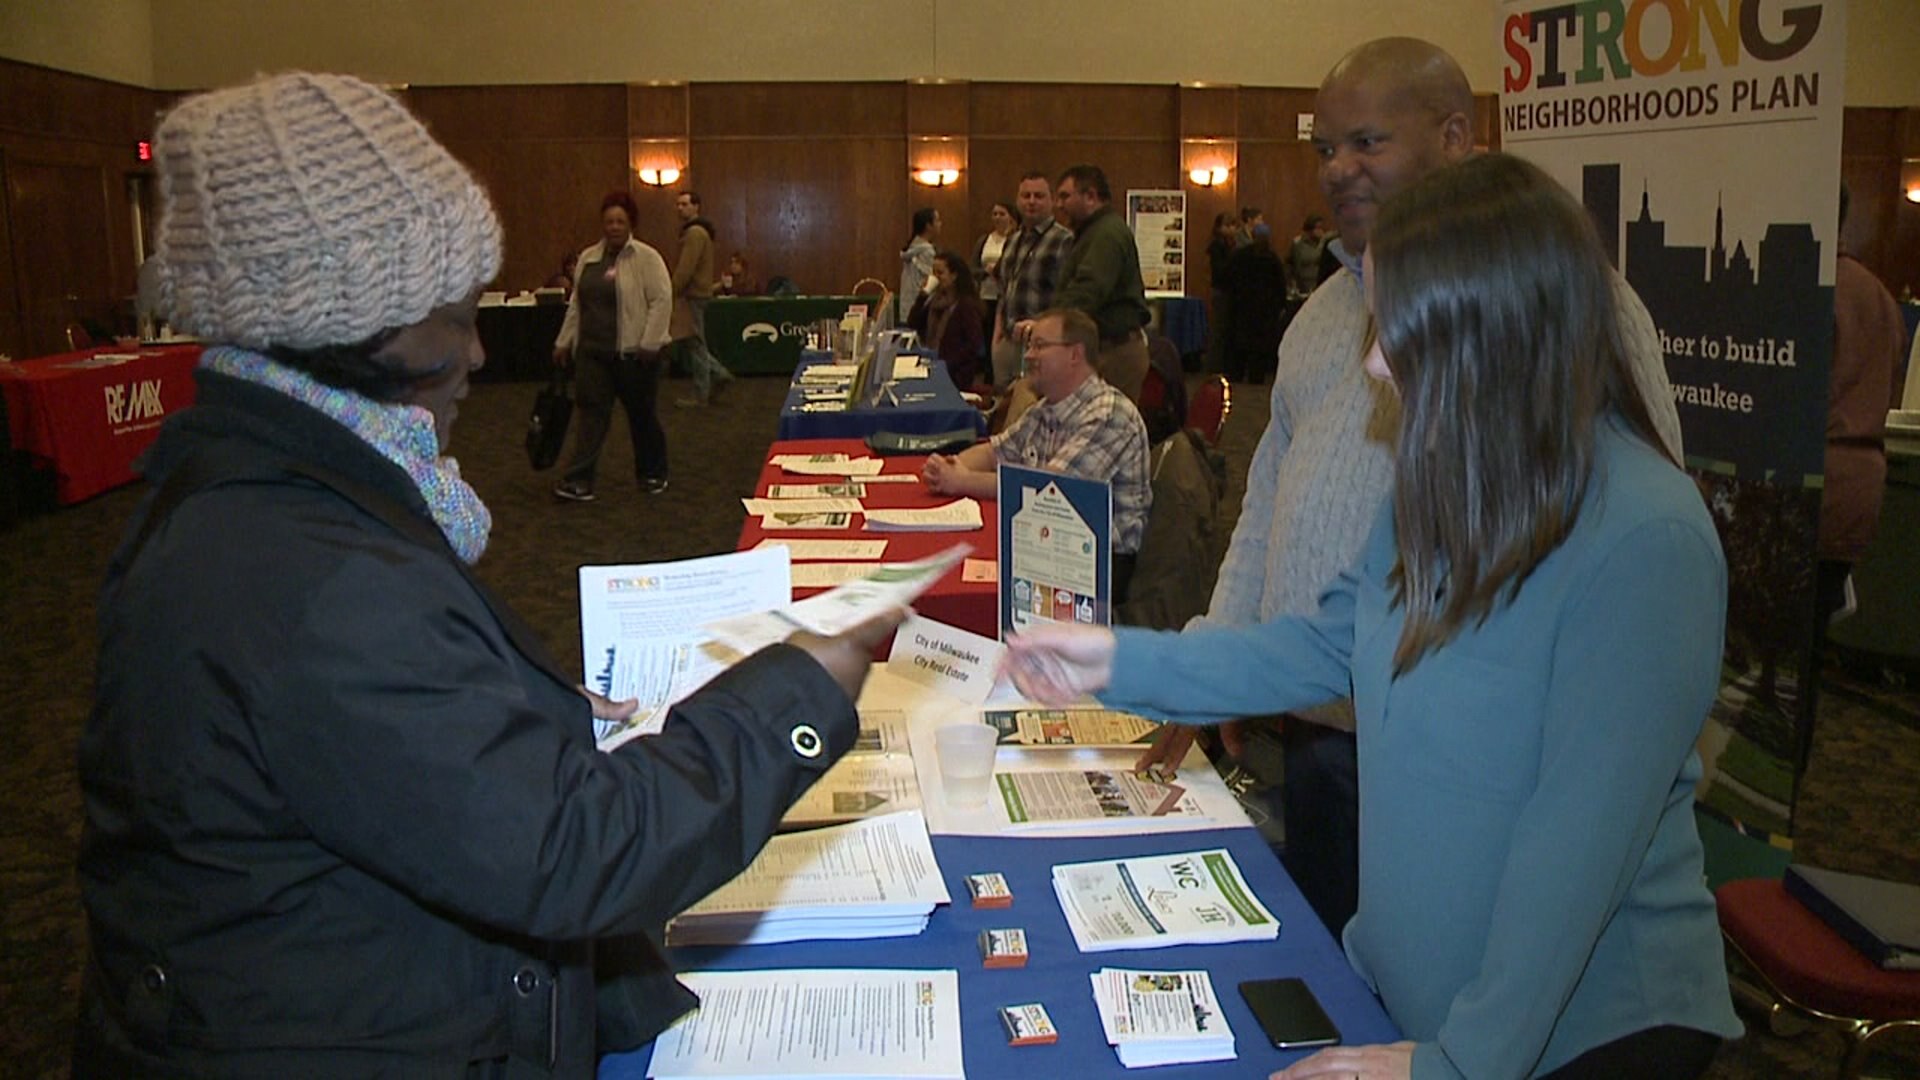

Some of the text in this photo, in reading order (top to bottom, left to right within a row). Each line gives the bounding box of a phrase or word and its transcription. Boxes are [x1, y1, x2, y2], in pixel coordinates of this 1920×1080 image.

[1504, 0, 1823, 94] STRONG
[1504, 73, 1820, 132] NEIGHBORHOODS PLAN
[1700, 335, 1720, 360] to
[1725, 336, 1797, 368] build
[915, 633, 980, 664] City of Milwaukee
[914, 654, 969, 682] City Real Estate
